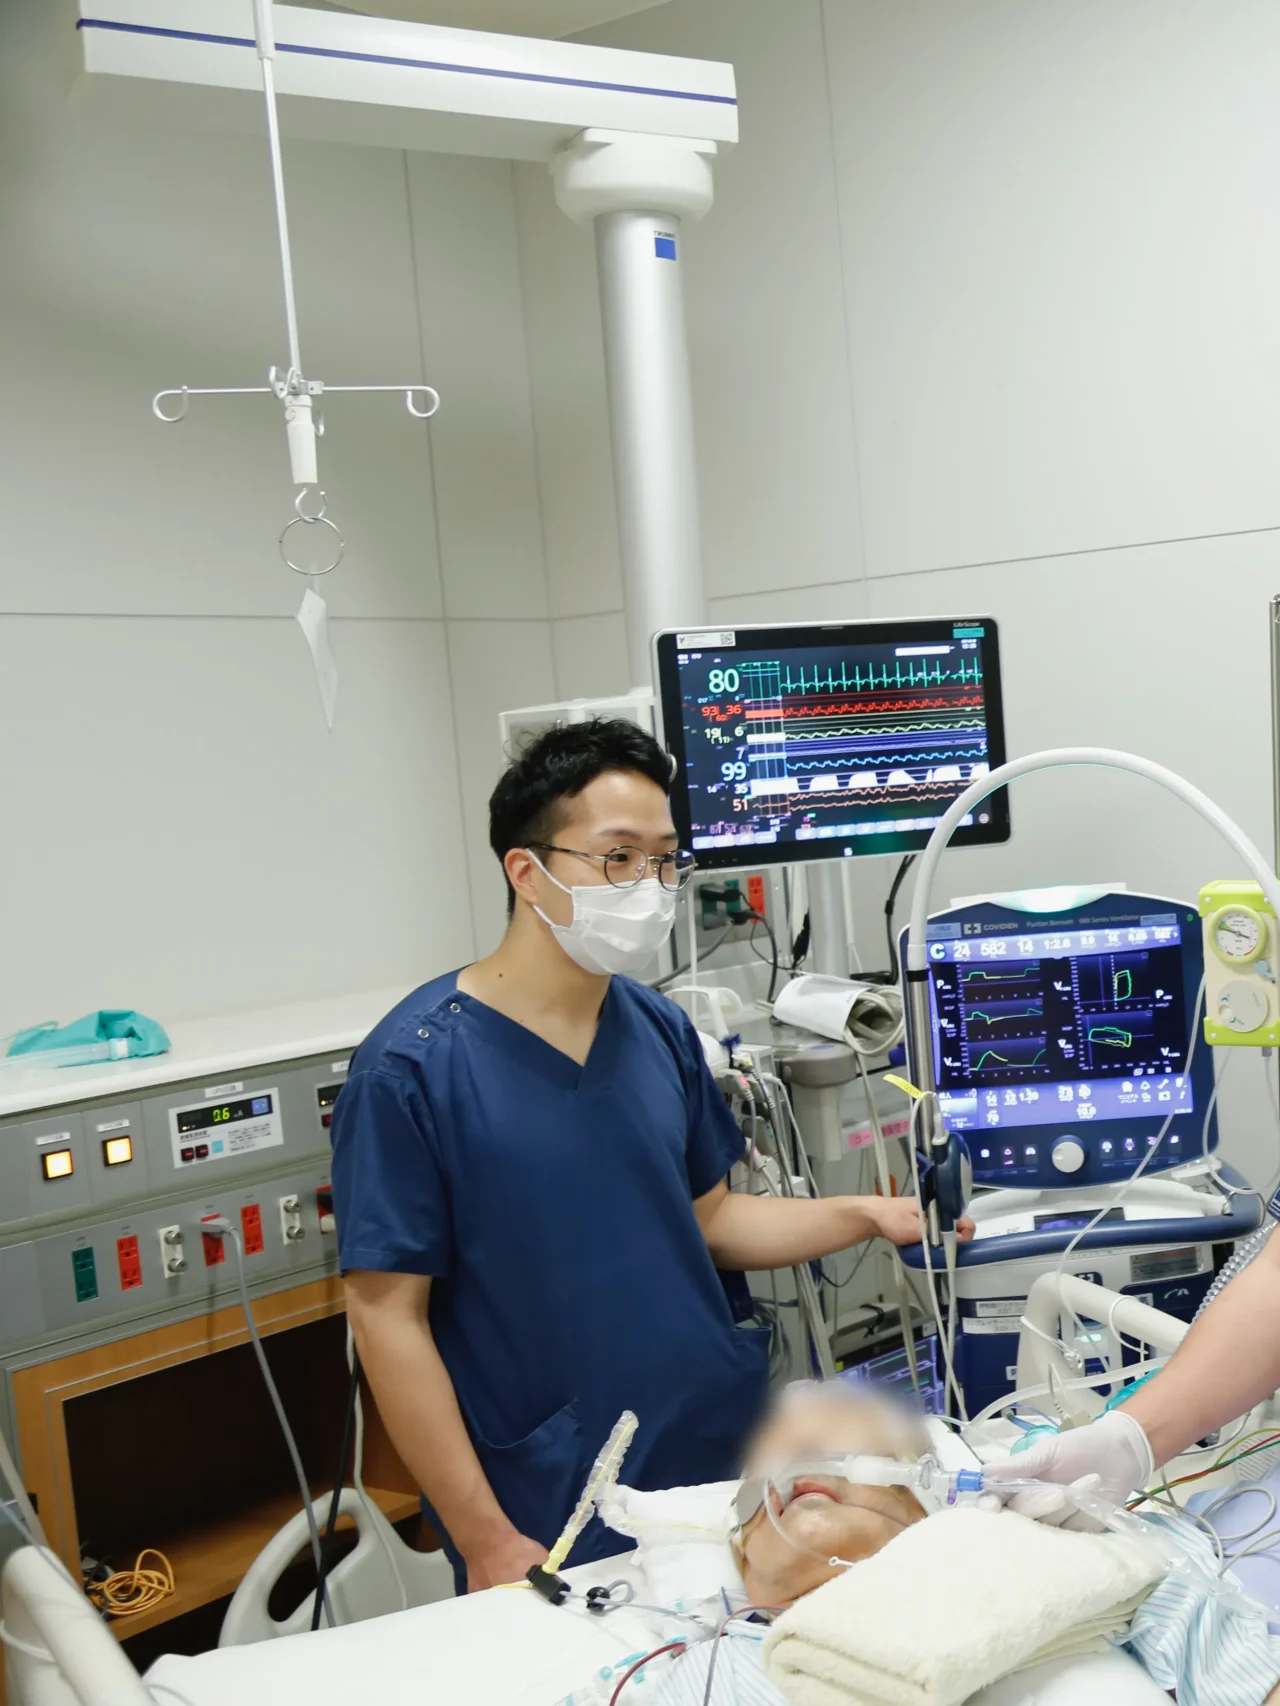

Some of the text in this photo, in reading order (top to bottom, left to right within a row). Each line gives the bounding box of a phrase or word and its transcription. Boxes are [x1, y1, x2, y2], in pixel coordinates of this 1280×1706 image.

[708, 668, 740, 693] 80
[725, 704, 742, 715] 36
[734, 726, 744, 737] 6
[736, 746, 745, 760] 7
[721, 761, 746, 781] 99
[733, 799, 748, 811] 51
[983, 922, 1018, 931] COVIDIEN
[930, 943, 945, 959] C
